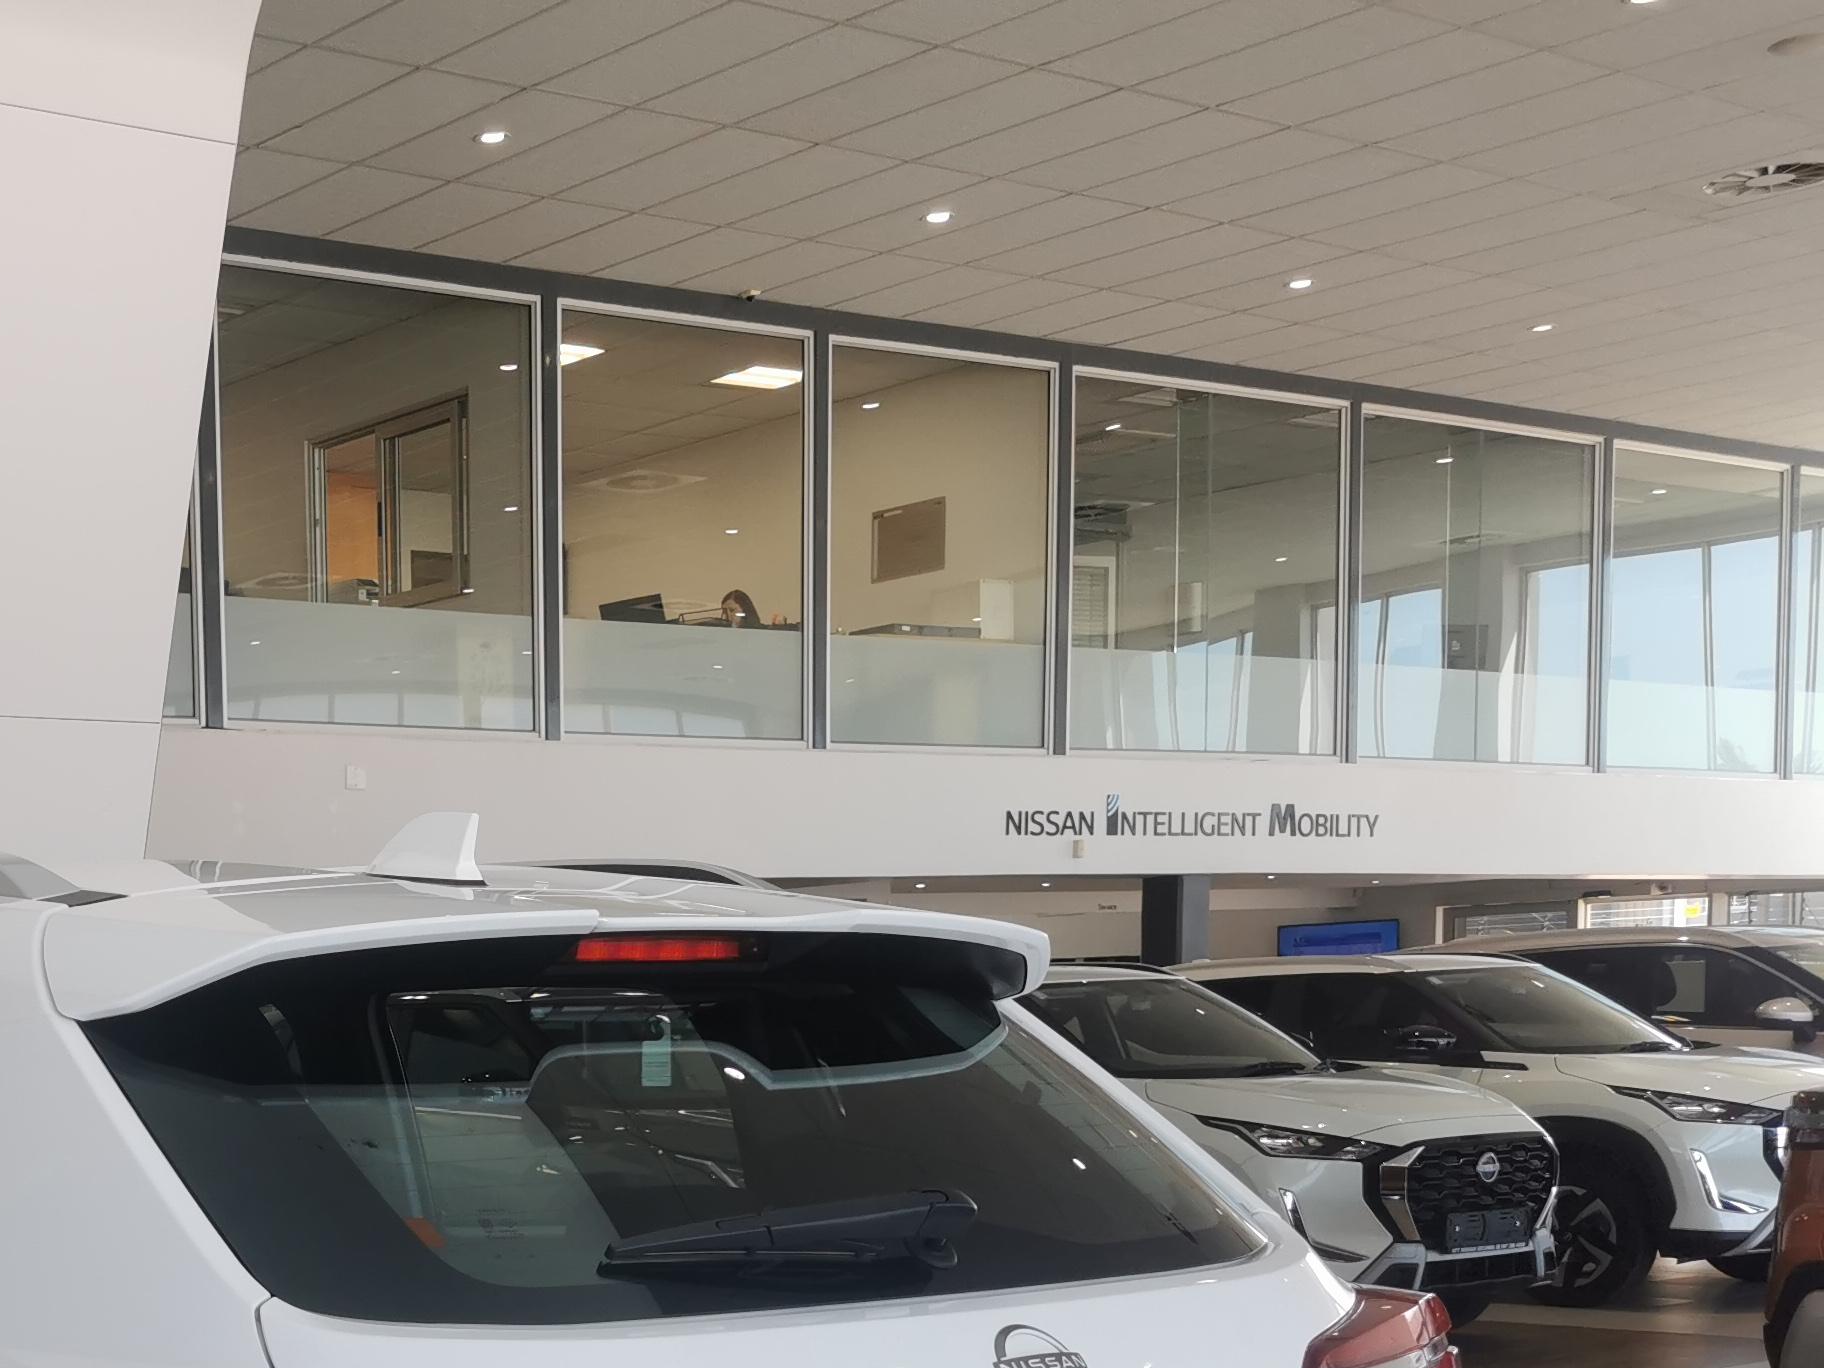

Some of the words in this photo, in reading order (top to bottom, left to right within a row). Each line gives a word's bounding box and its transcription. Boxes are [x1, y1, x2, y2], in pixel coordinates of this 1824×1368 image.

[1005, 810, 1094, 836] NISSAN
[1106, 794, 1261, 837] INTELLIGENT
[1268, 803, 1379, 838] MOBILITY
